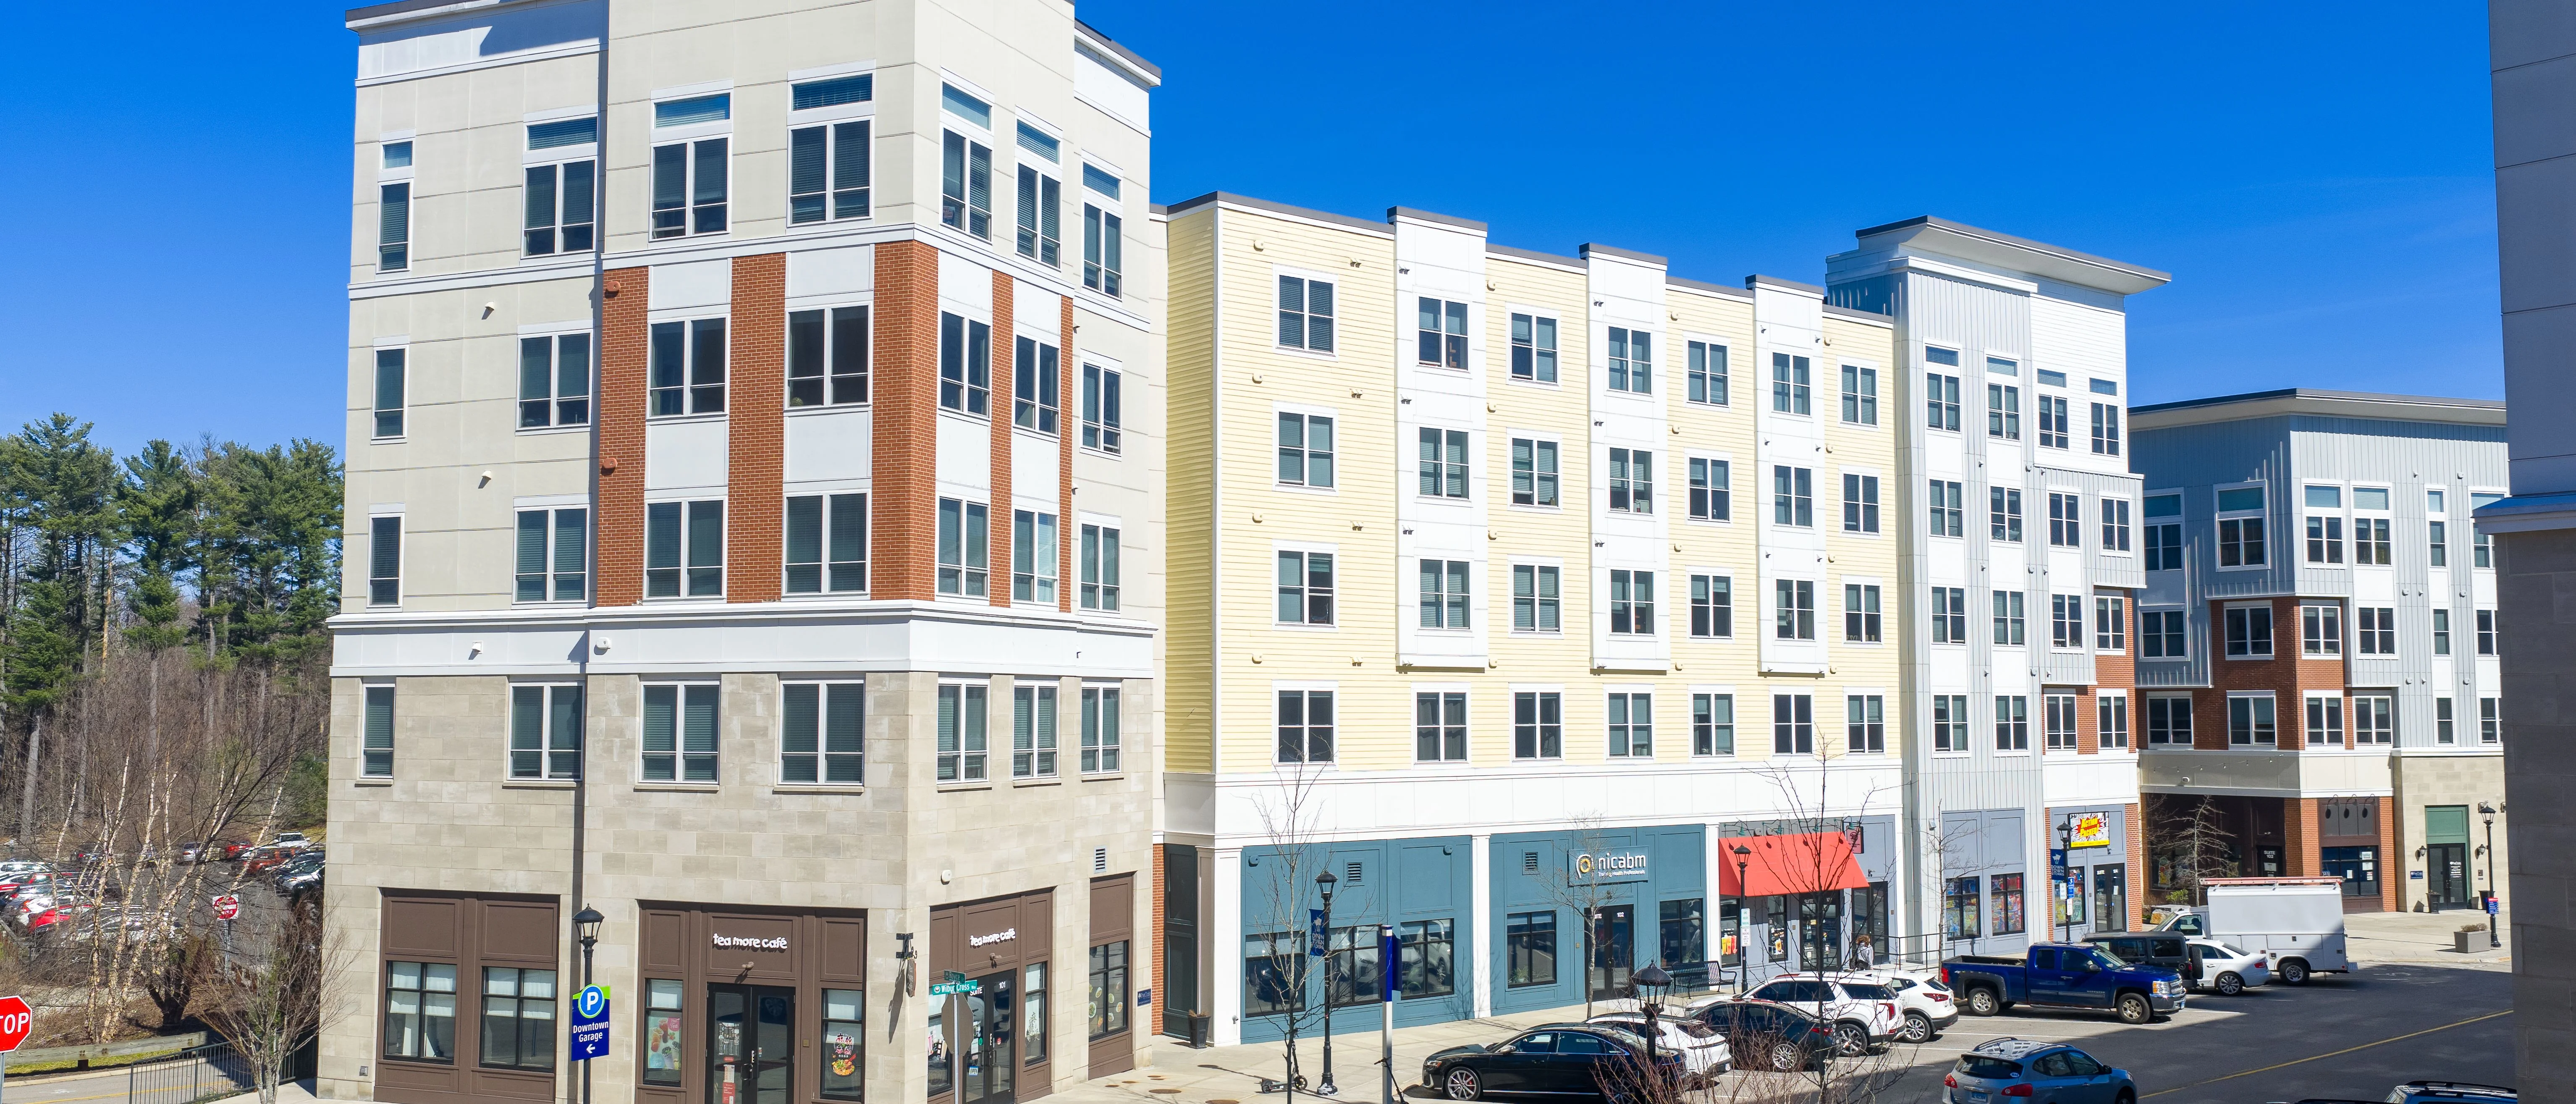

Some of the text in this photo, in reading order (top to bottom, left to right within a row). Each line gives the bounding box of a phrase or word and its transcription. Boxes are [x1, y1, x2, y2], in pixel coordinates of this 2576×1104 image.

[1599, 852, 1646, 869] nicabm
[713, 933, 787, 949] tea more café
[970, 935, 983, 946] tea
[983, 934, 1000, 943] more
[949, 972, 960, 980] Royce
[587, 991, 599, 1011] P
[573, 1021, 609, 1033] Downtown
[579, 1032, 603, 1043] Garage
